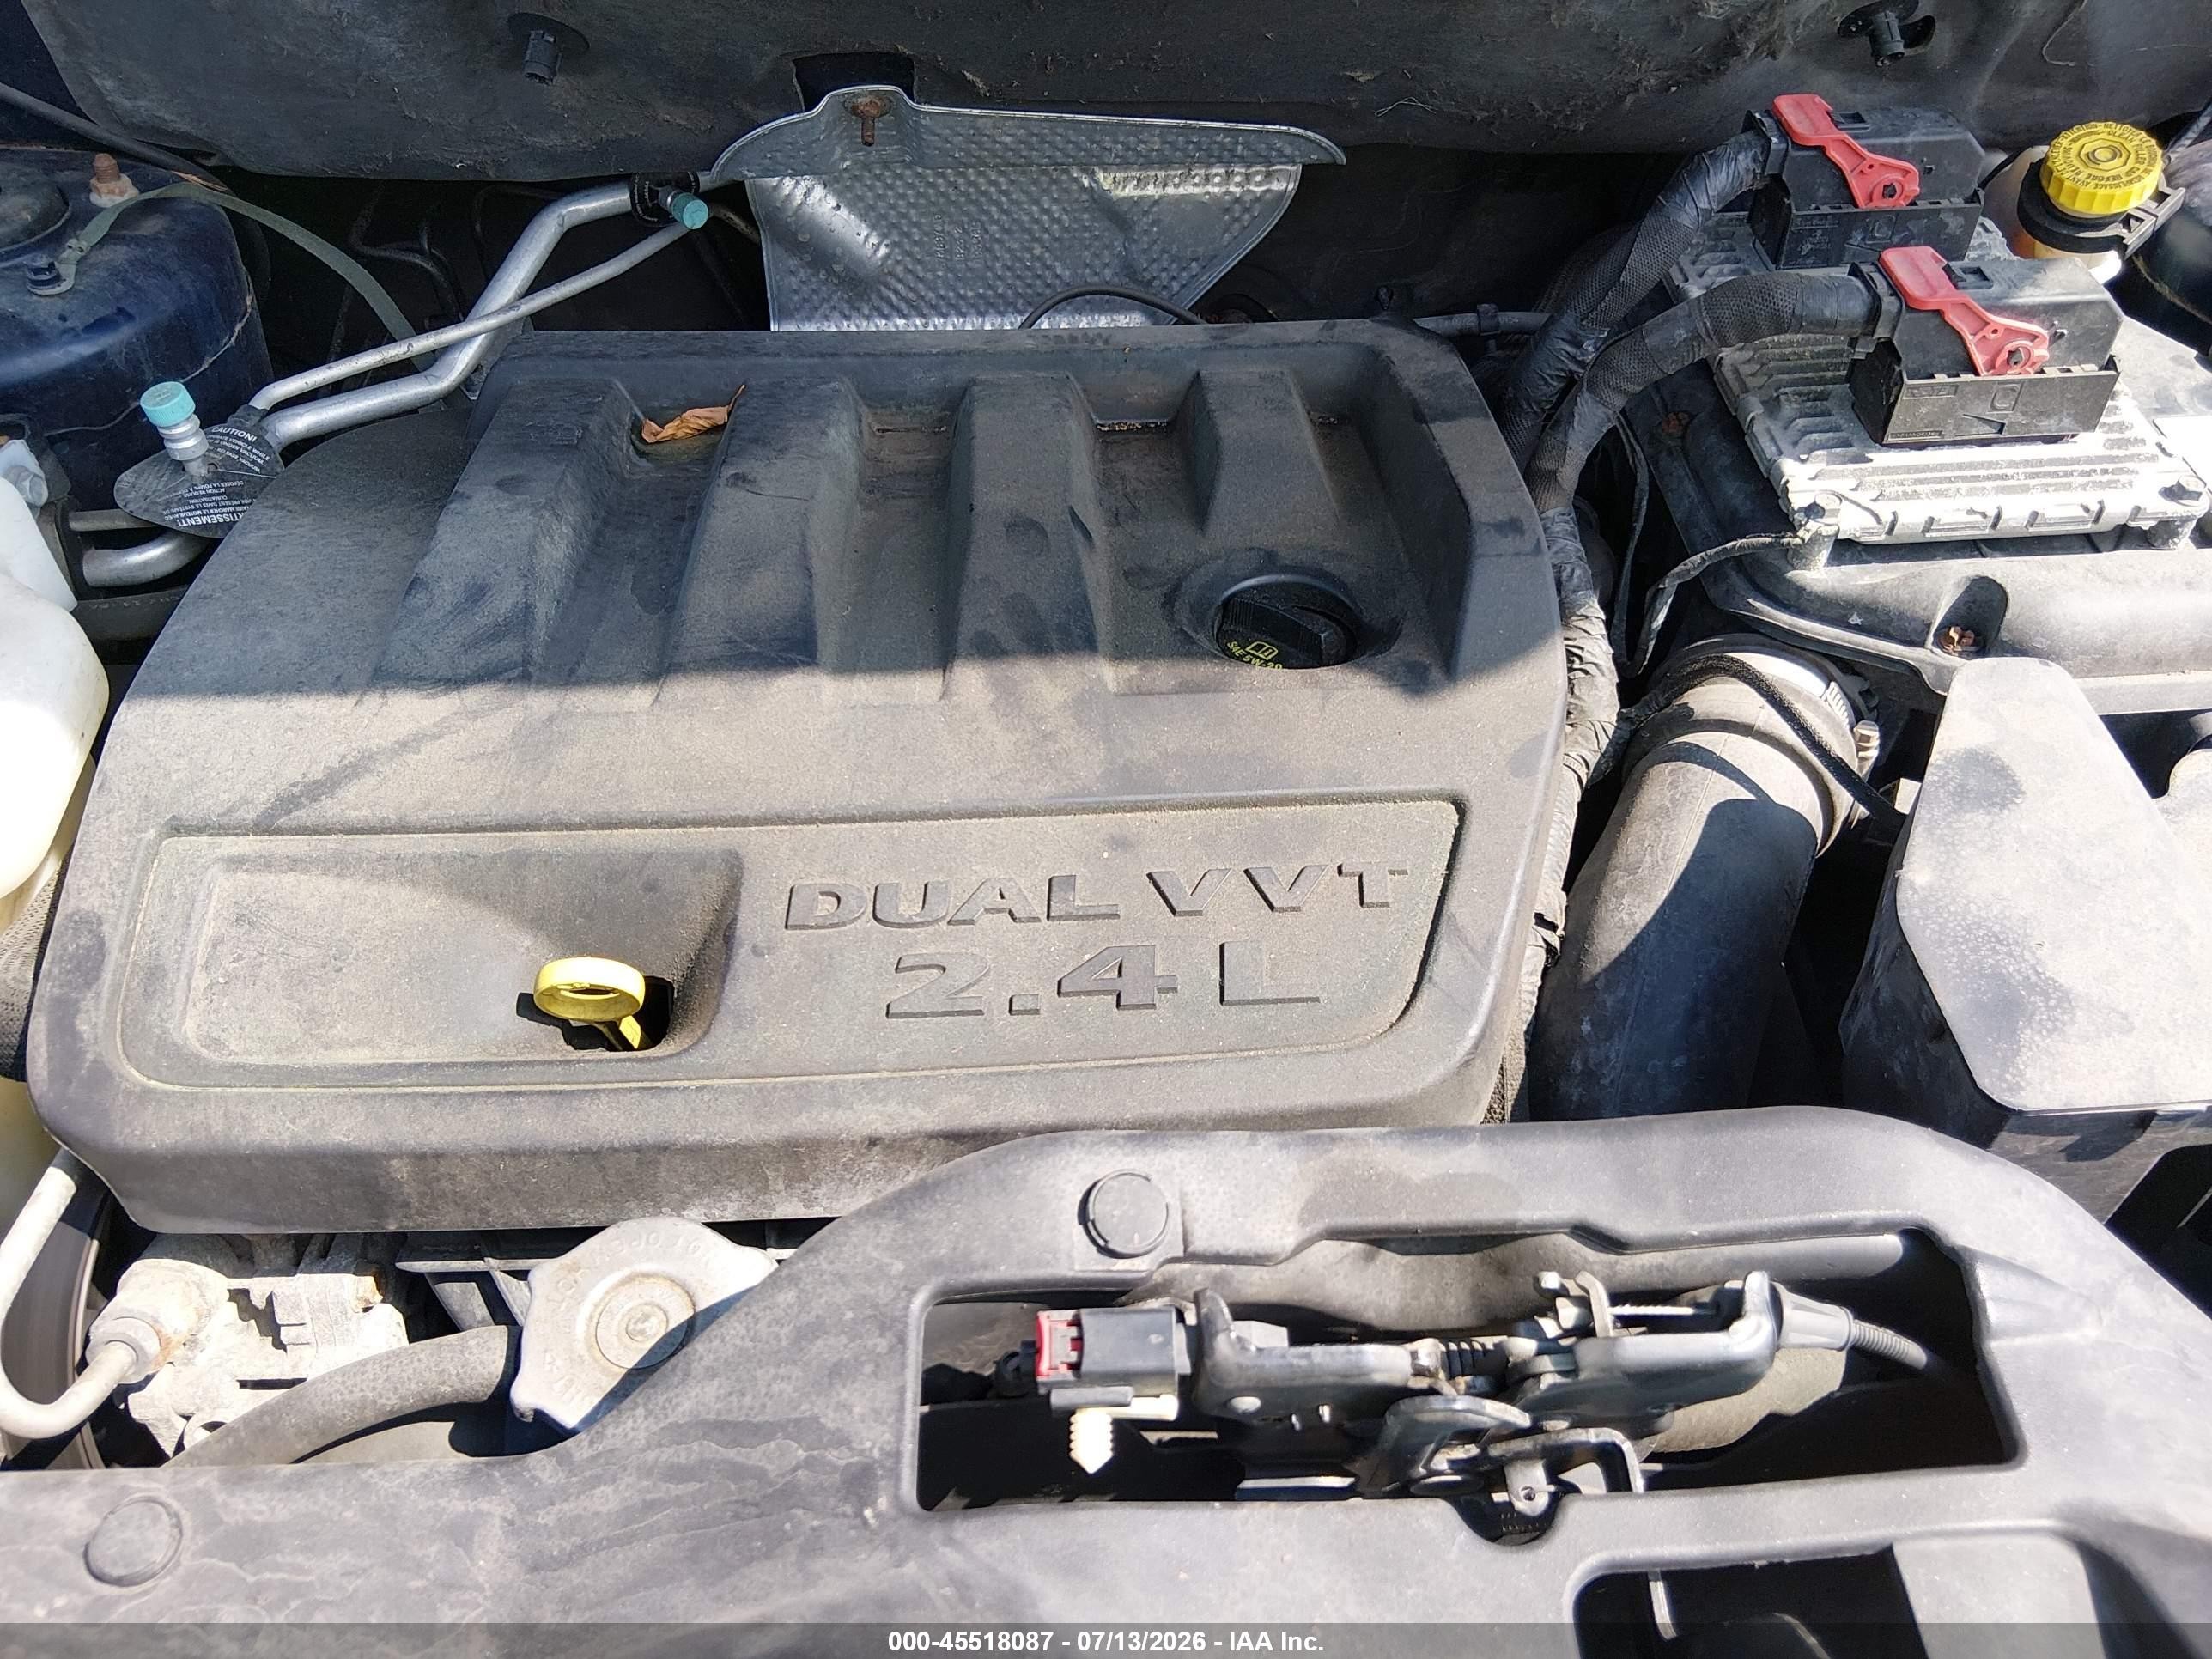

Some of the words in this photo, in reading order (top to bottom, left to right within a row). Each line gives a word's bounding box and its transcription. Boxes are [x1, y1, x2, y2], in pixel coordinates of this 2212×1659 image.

[2104, 122, 2142, 138] NETTOYER
[2107, 130, 2136, 143] CLEAN
[2067, 173, 2091, 187] AVANT
[2086, 173, 2124, 182] BEFORE
[211, 427, 258, 442] CAUTION!
[220, 441, 240, 451] UNDER
[252, 448, 270, 461] WHILE
[177, 513, 244, 526] RTISSEMENT!
[1227, 641, 1247, 656] SAE
[785, 874, 1120, 930] DUAL
[1146, 862, 1408, 917] VVT
[886, 945, 1177, 1019] 2.4
[1219, 941, 1321, 1006] L
